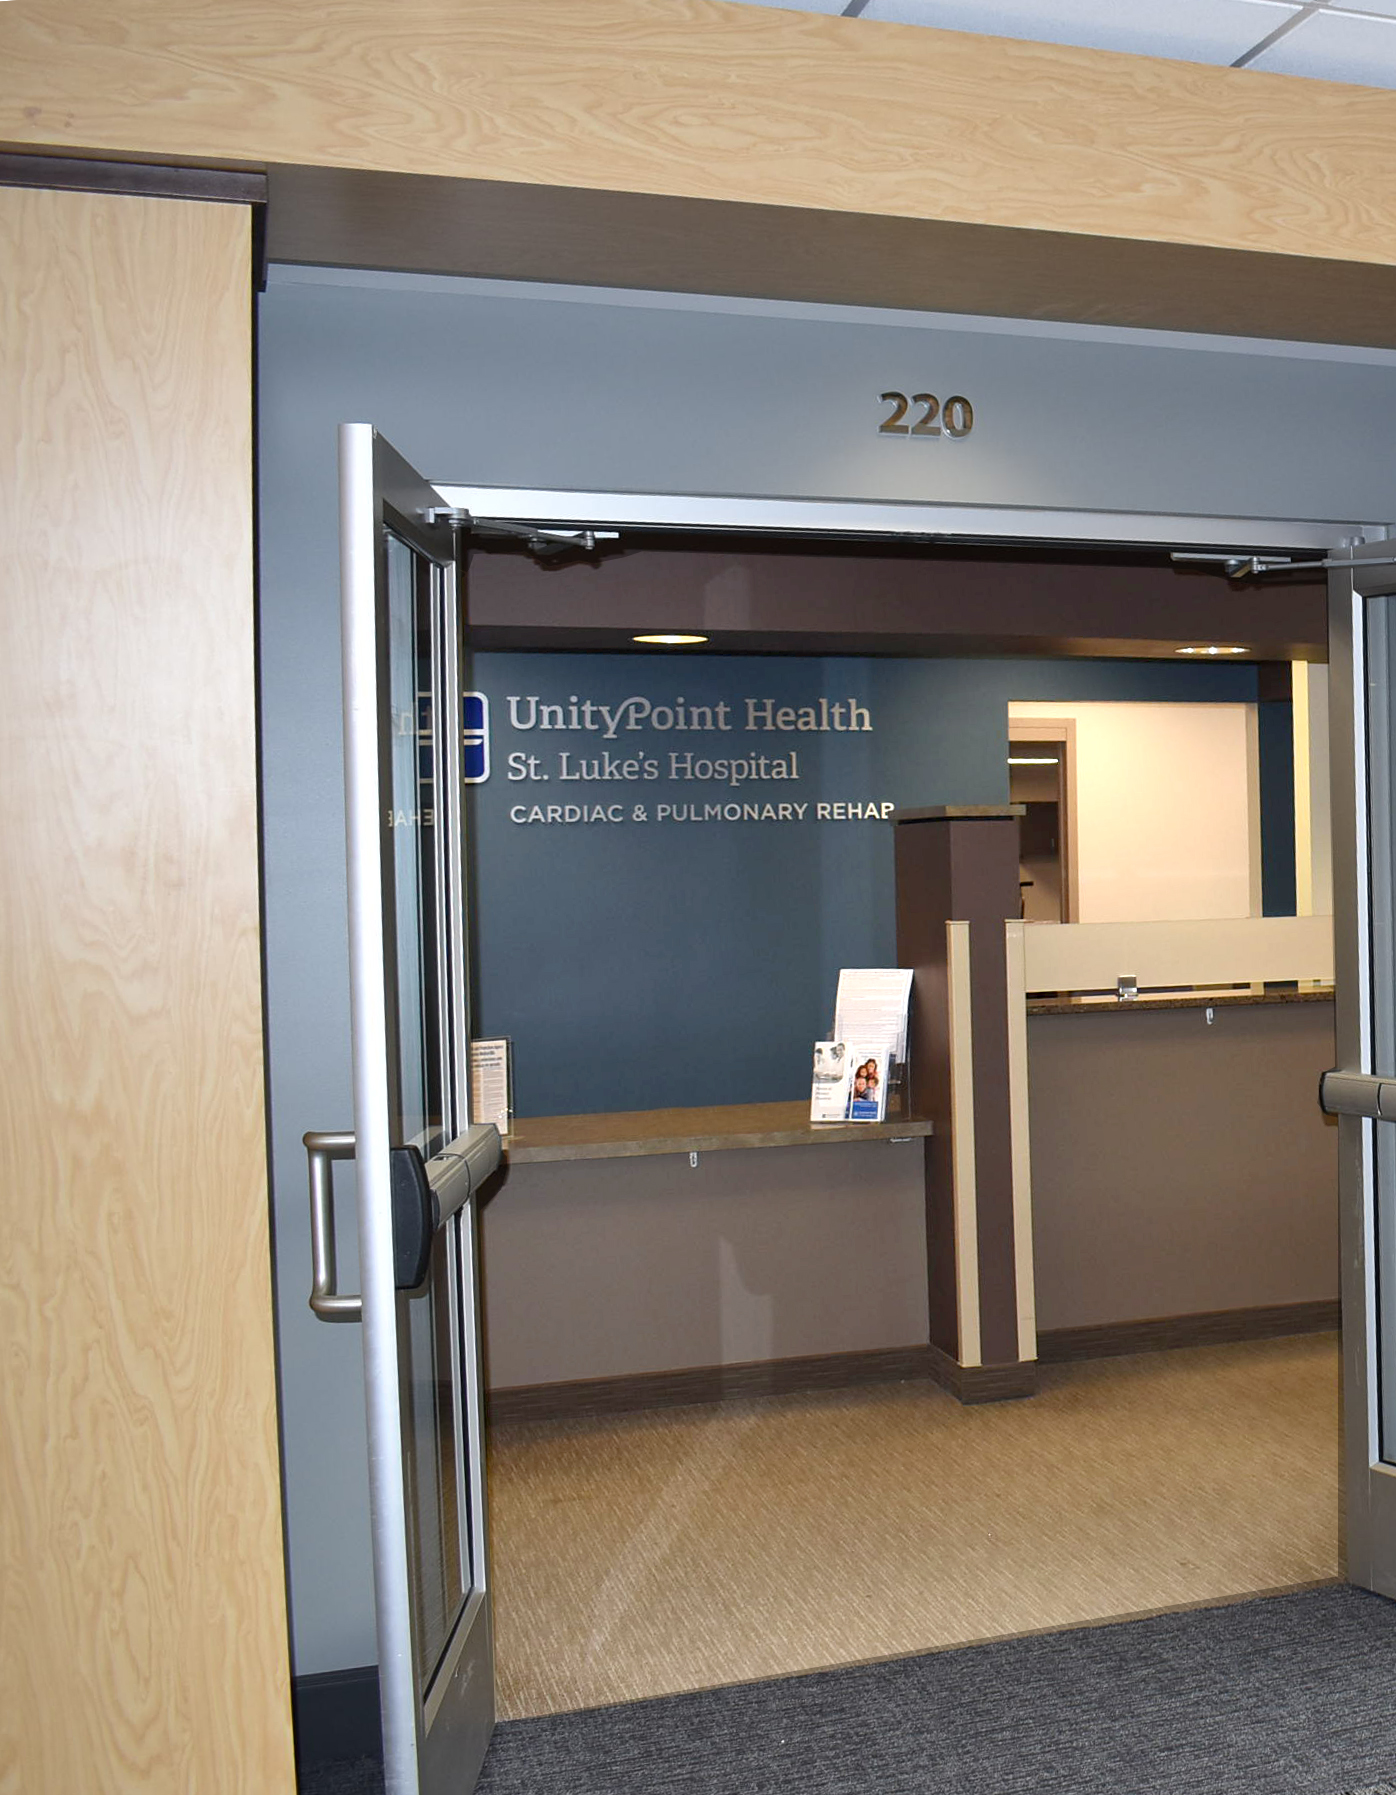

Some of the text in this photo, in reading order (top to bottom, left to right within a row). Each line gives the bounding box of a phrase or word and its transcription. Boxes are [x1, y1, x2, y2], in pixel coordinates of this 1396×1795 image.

[877, 390, 974, 439] 220
[506, 695, 873, 739] UnityPoint Health
[507, 750, 799, 786] St. Luke's Hospital
[510, 804, 624, 824] CARDIAC
[632, 804, 648, 823] &
[657, 802, 807, 822] PULMONARY
